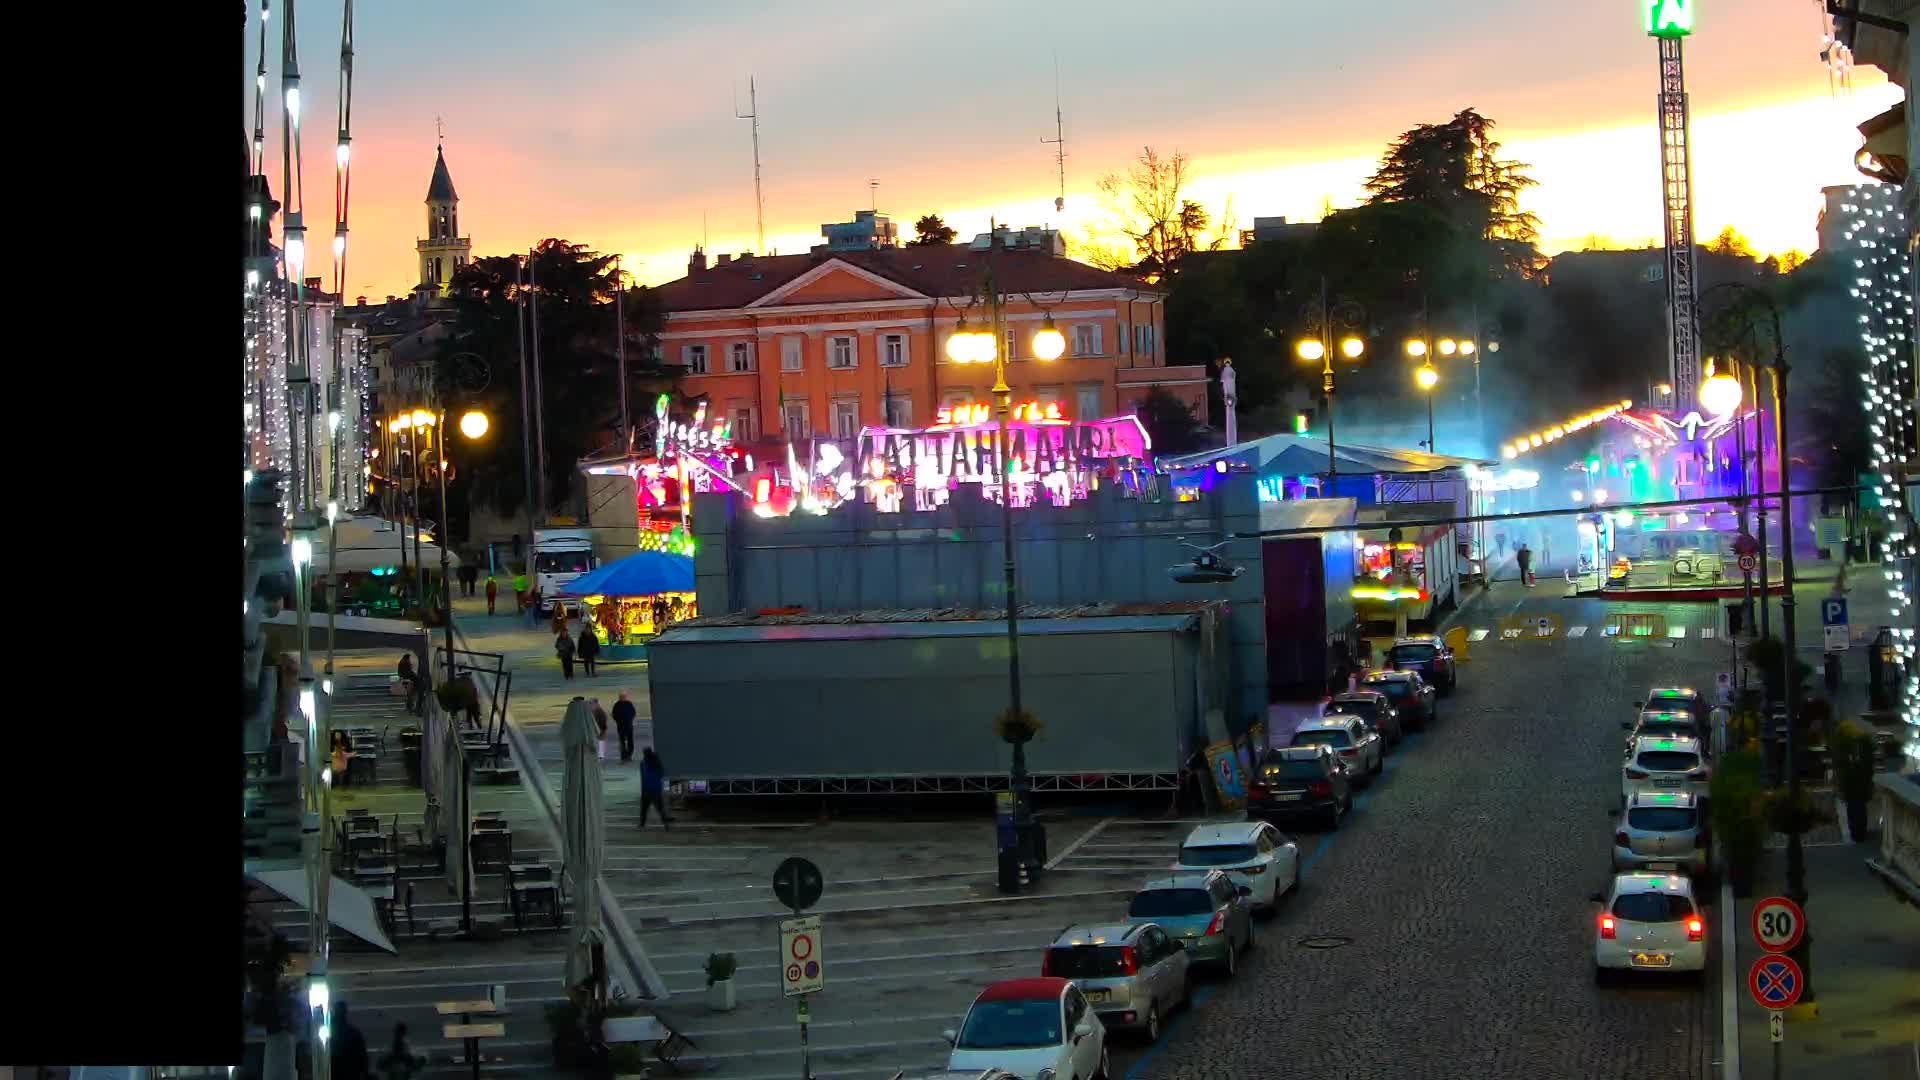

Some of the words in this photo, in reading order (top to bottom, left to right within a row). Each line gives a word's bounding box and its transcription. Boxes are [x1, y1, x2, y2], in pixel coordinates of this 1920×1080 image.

[1742, 557, 1753, 567] 20
[1827, 602, 1841, 622] P
[1762, 912, 1791, 937] 30
